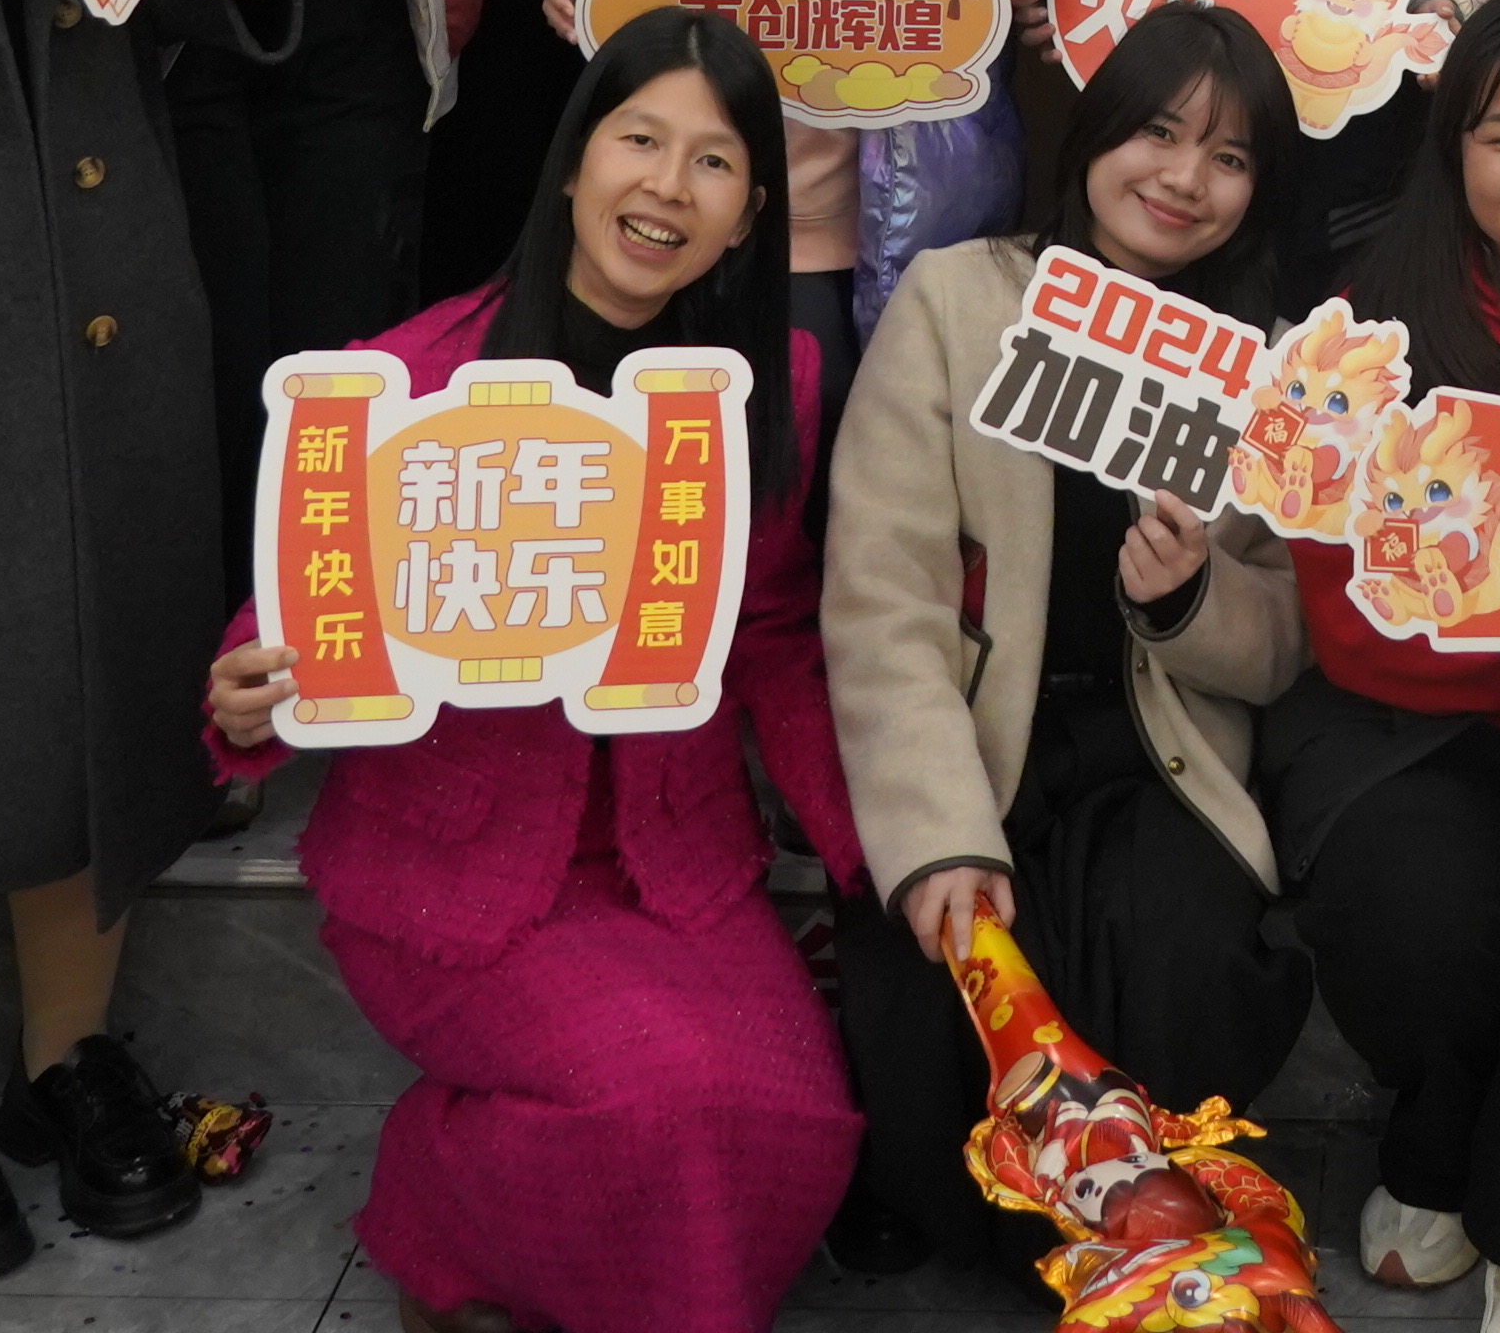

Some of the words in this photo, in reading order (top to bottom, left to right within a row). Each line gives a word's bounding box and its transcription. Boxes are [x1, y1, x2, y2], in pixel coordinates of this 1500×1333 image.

[1032, 257, 1259, 399] 2024
[979, 327, 1241, 513] 加油
[1263, 416, 1289, 445] 福
[296, 424, 365, 662] 新年快乐
[397, 437, 616, 533] 新年
[636, 418, 712, 649] 万事如意
[393, 538, 609, 635] 快乐
[1380, 531, 1408, 563] 福
